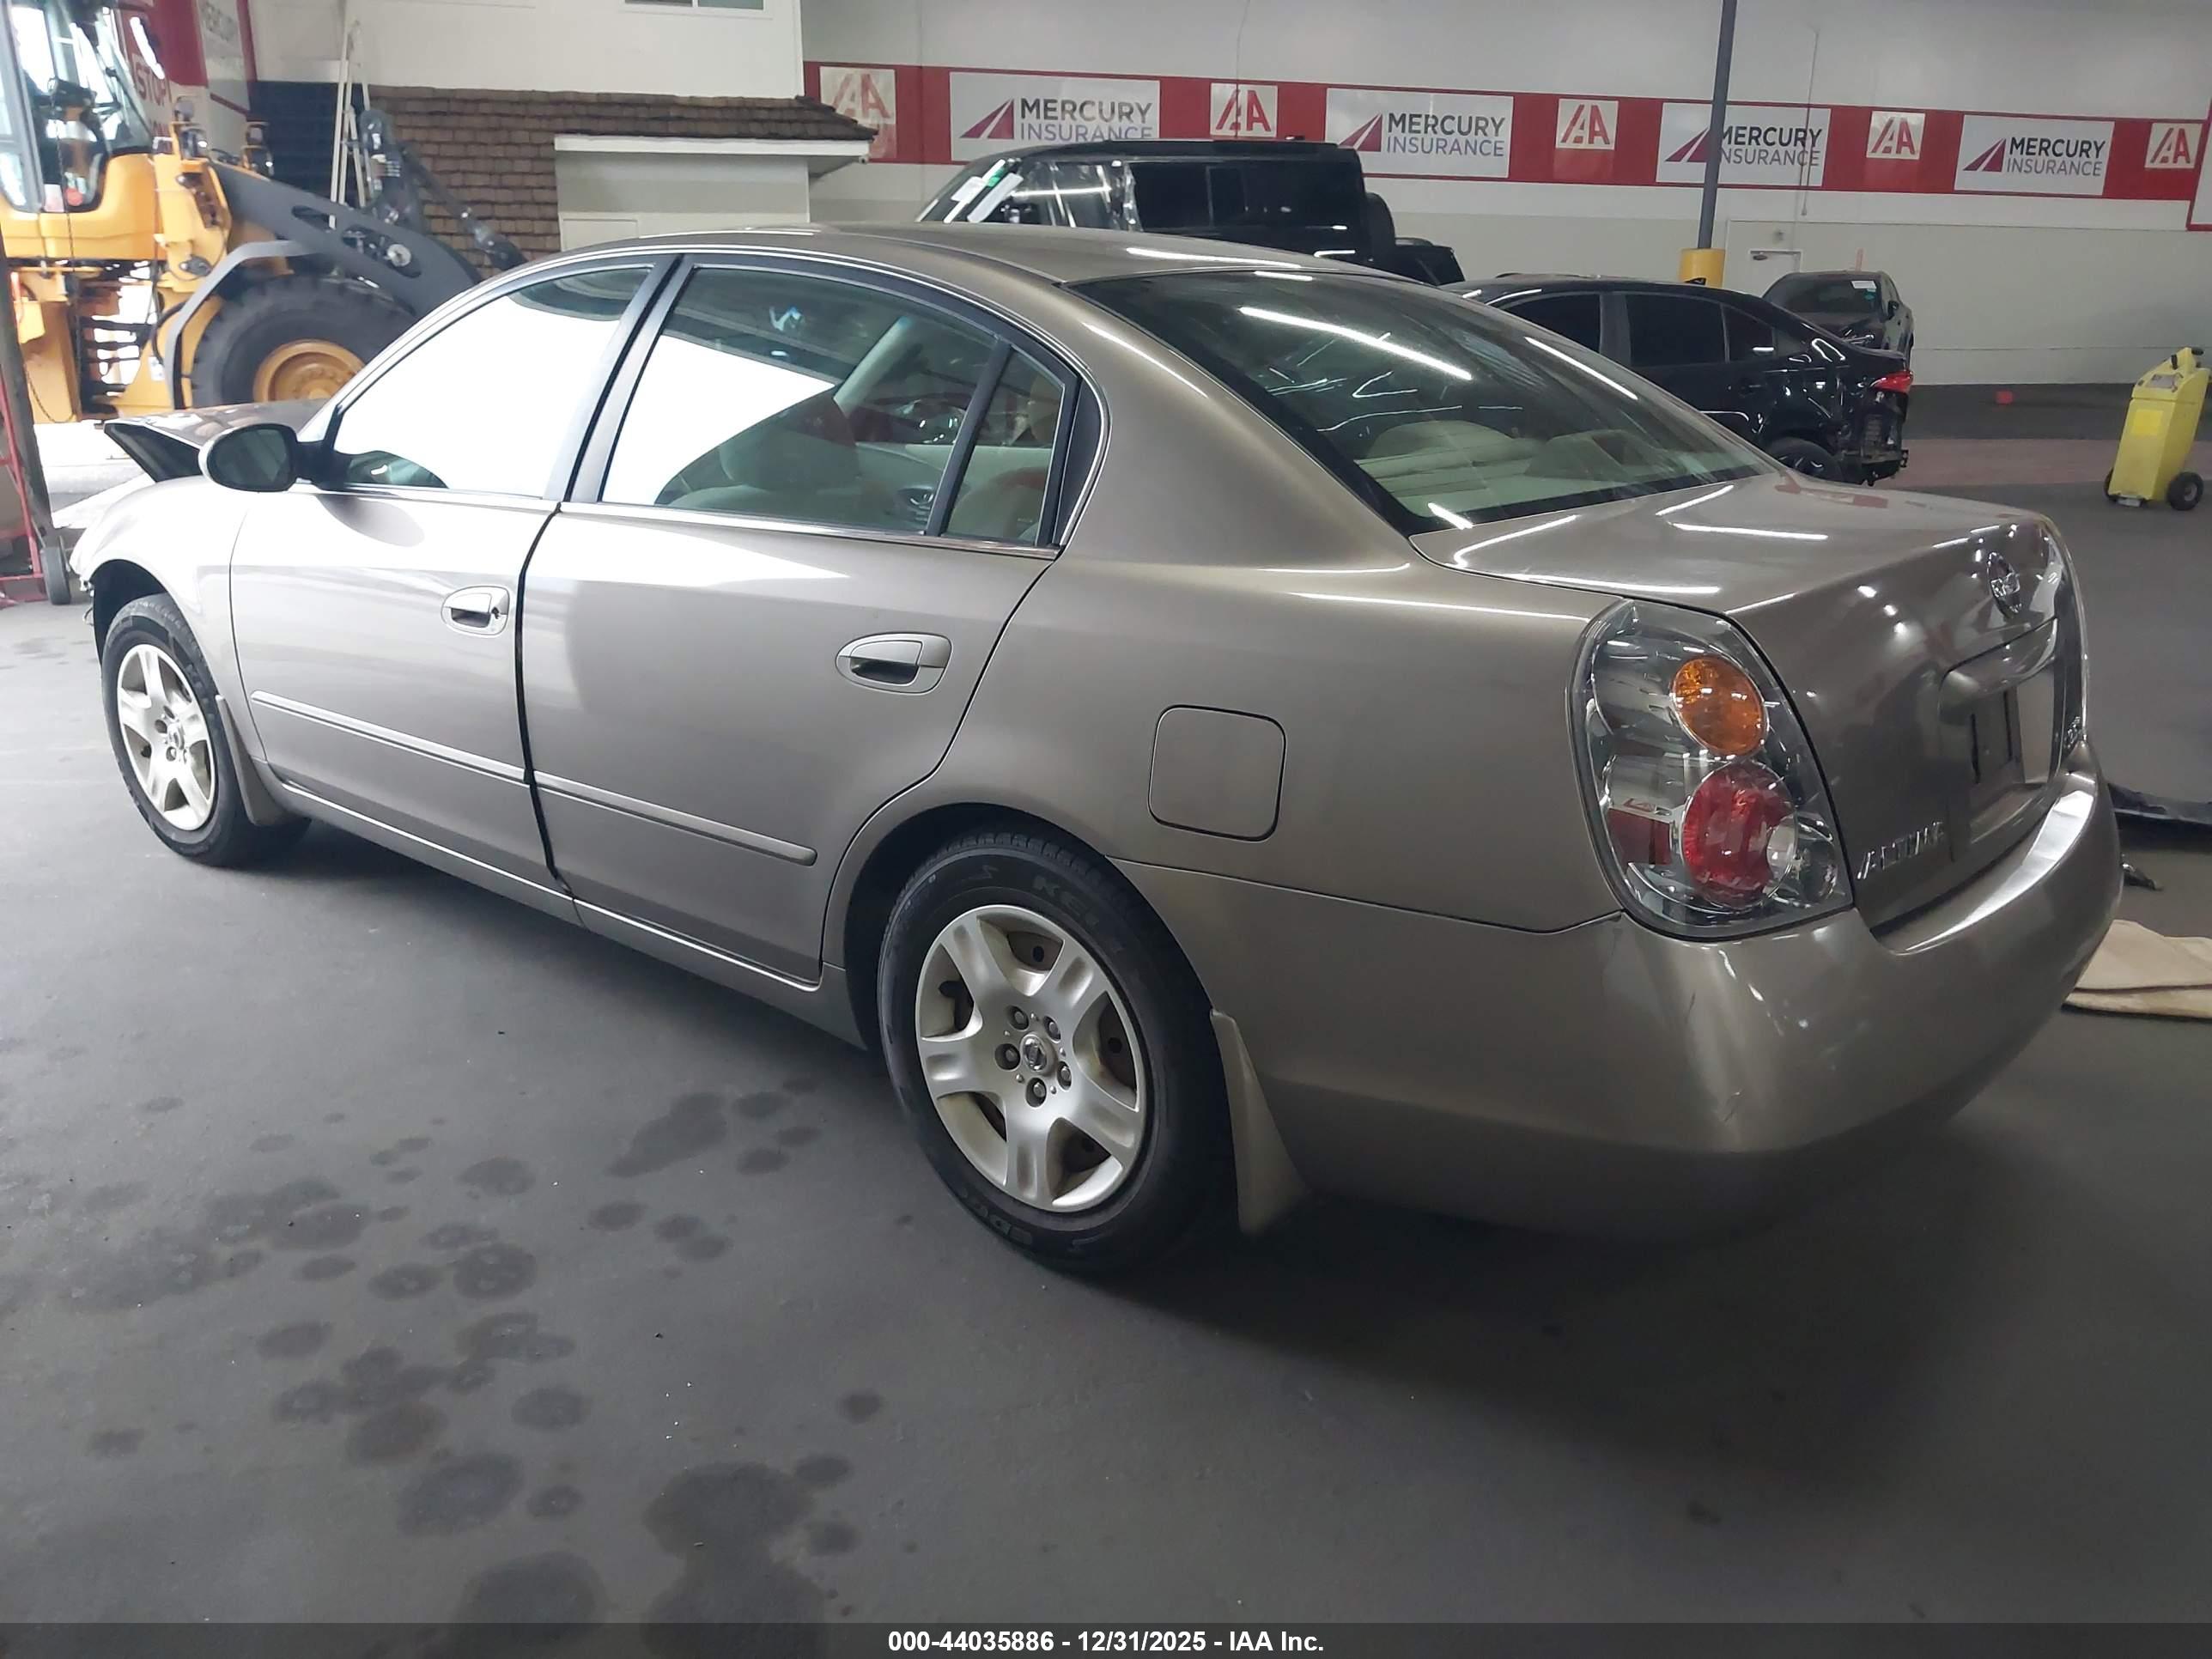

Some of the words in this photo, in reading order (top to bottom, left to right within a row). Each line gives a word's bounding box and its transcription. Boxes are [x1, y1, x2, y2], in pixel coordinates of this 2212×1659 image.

[1020, 98, 1153, 124] MERCURY
[1388, 112, 1505, 137] MERCURY
[1387, 136, 1505, 156] INSURANCE
[2009, 137, 2106, 159] MERCURY
[1722, 148, 1821, 166] NSURANCE
[2007, 157, 2103, 177] INSURANCE
